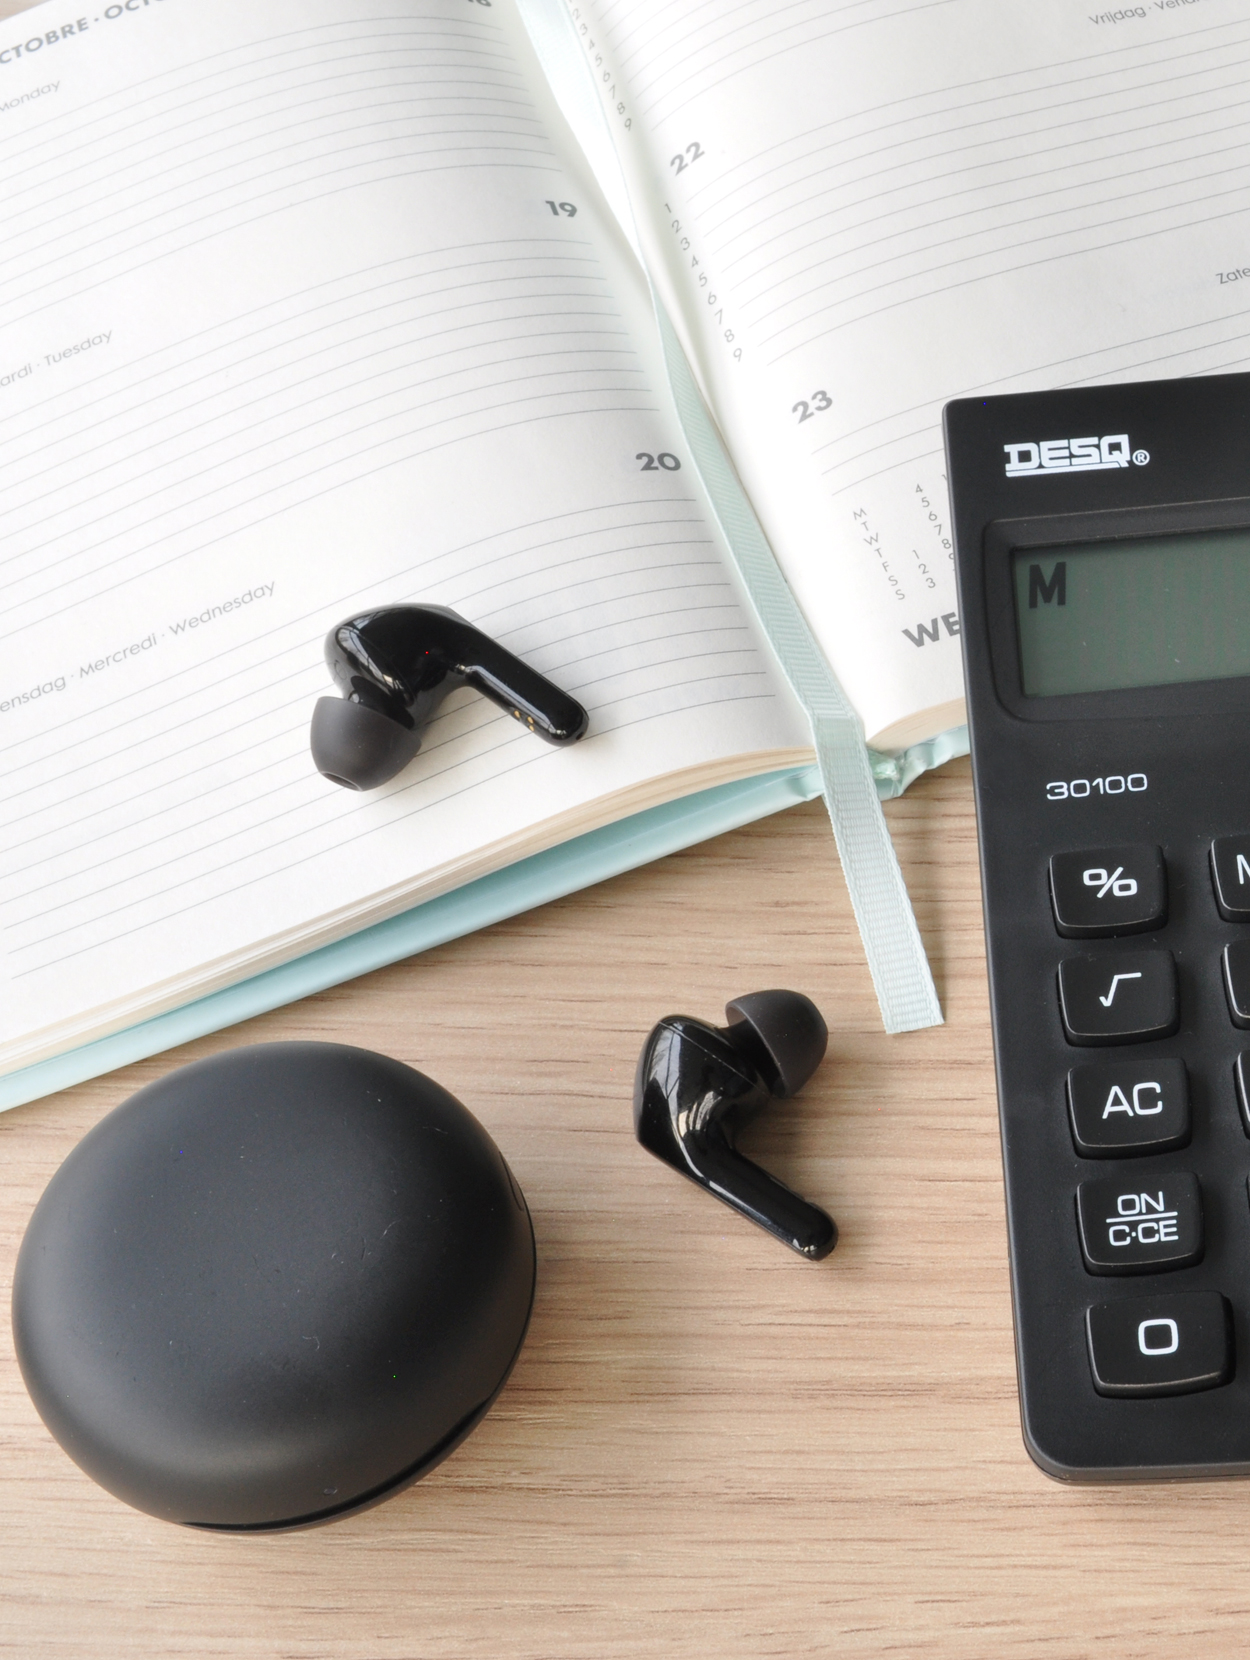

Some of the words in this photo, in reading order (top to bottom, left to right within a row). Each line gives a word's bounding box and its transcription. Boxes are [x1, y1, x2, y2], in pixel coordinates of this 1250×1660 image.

[573, 8, 581, 20] 2
[1088, 6, 1147, 25] Vrijdag
[580, 23, 588, 36] 3
[589, 39, 596, 50] 4
[595, 53, 603, 67] 5
[603, 70, 611, 82] 6
[608, 84, 616, 99] 7
[617, 102, 626, 115] 8
[624, 118, 632, 132] 9
[670, 141, 705, 175] 22
[545, 200, 577, 218] 19
[664, 203, 672, 214] 1
[671, 220, 682, 233] 2
[680, 237, 690, 250] 3
[691, 255, 700, 268] 4
[699, 272, 708, 287] 5
[707, 291, 717, 305] 6
[714, 308, 723, 325] 7
[724, 329, 735, 343] 8
[0, 363, 32, 388] ardi
[44, 330, 112, 366] Tuesday
[733, 348, 743, 362] 9
[792, 390, 833, 424] 23
[635, 452, 681, 471] 20
[853, 507, 867, 521] M
[915, 484, 923, 494] 4
[861, 521, 869, 531] T
[921, 497, 930, 508] 5
[863, 532, 879, 546] W
[928, 511, 938, 521] 6
[874, 547, 883, 558] T
[933, 523, 942, 536] 7
[881, 561, 890, 573] F
[912, 549, 920, 560] 1
[941, 538, 952, 549] 8
[888, 575, 898, 587] S
[918, 563, 929, 575] 2
[895, 589, 905, 601] S
[926, 577, 936, 589] 3
[1029, 562, 1067, 610] M
[79, 633, 157, 679] Mercredi
[169, 581, 275, 636] Wednesday
[1046, 773, 1148, 800] 30100
[1102, 1081, 1163, 1120] AC
[1117, 1191, 1164, 1216] ON
